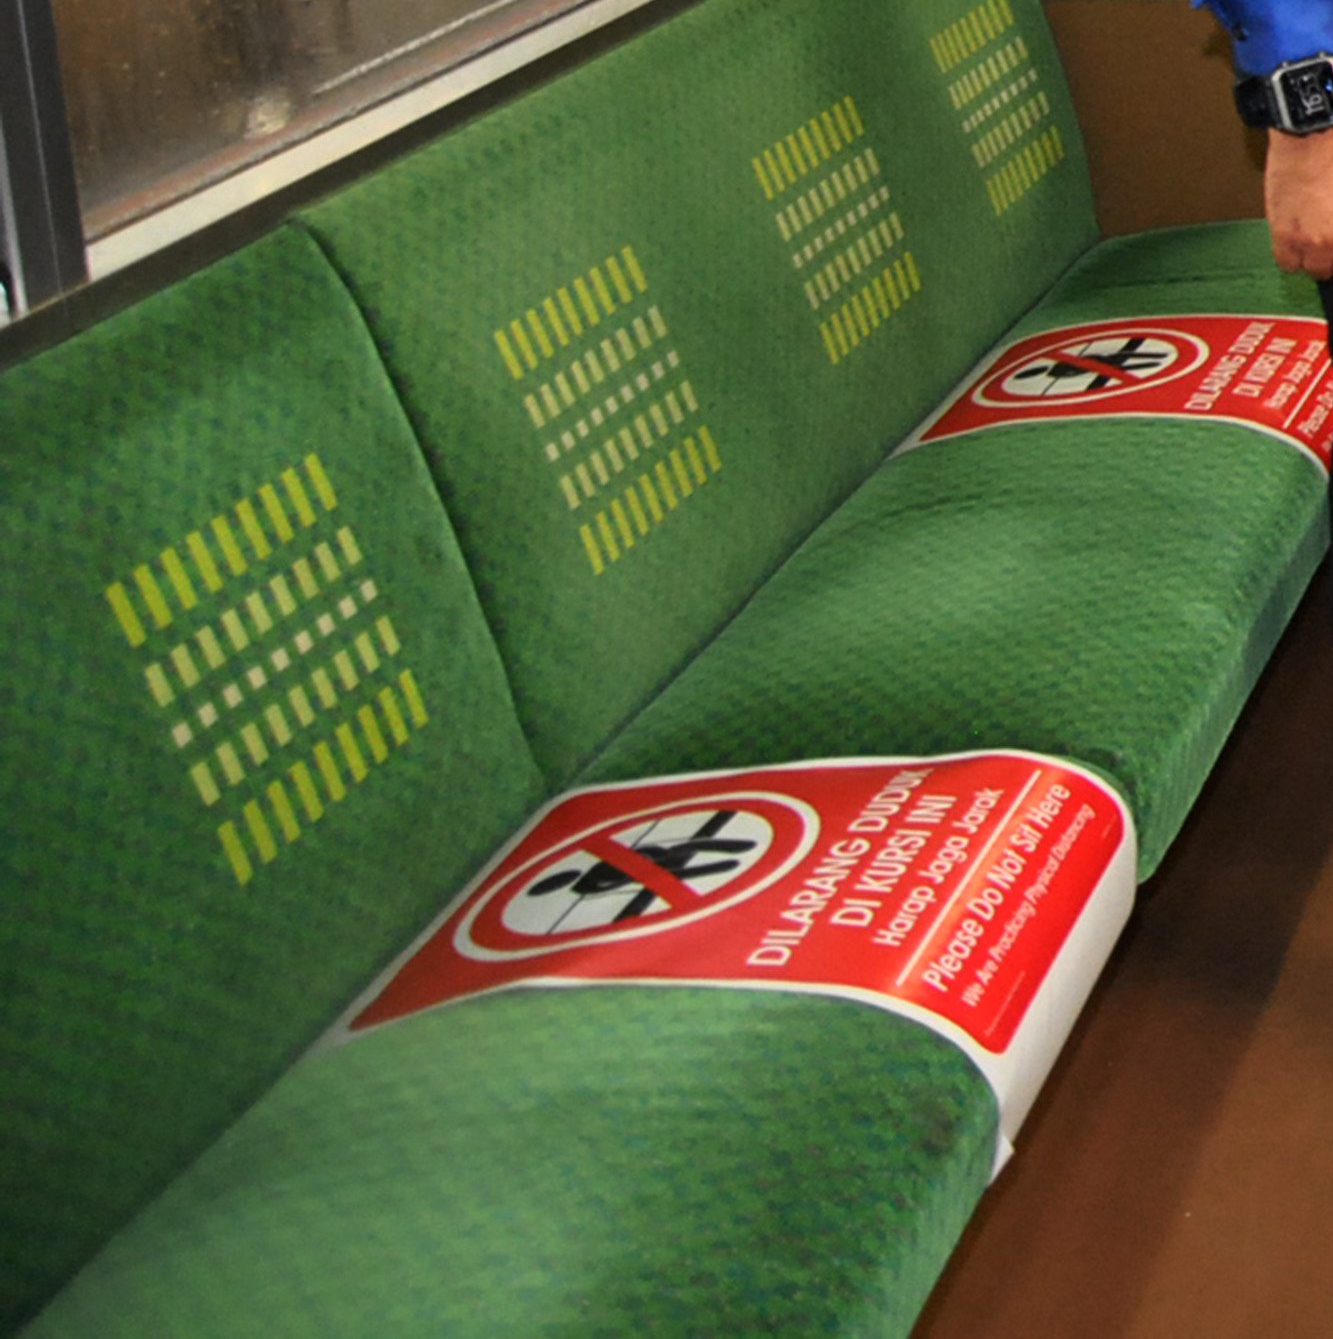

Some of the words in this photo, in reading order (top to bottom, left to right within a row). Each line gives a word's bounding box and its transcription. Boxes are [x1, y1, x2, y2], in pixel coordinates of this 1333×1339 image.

[748, 838, 871, 965] DILARANG
[847, 768, 934, 833] DUDUK
[854, 828, 933, 893] KURSI
[872, 885, 937, 947] Harap
[918, 835, 969, 884] Jaga
[953, 786, 1005, 835] Jarak
[905, 794, 958, 824] INI
[829, 898, 882, 927] DI
[921, 917, 985, 993] Please
[966, 883, 1005, 922] Do
[987, 847, 1028, 891] Not
[1010, 821, 1043, 853] Sit
[1027, 783, 1072, 832] Here
[961, 983, 985, 1008] We
[976, 959, 997, 986] Are
[989, 899, 1037, 964] Practicing
[1024, 855, 1061, 904] Physical
